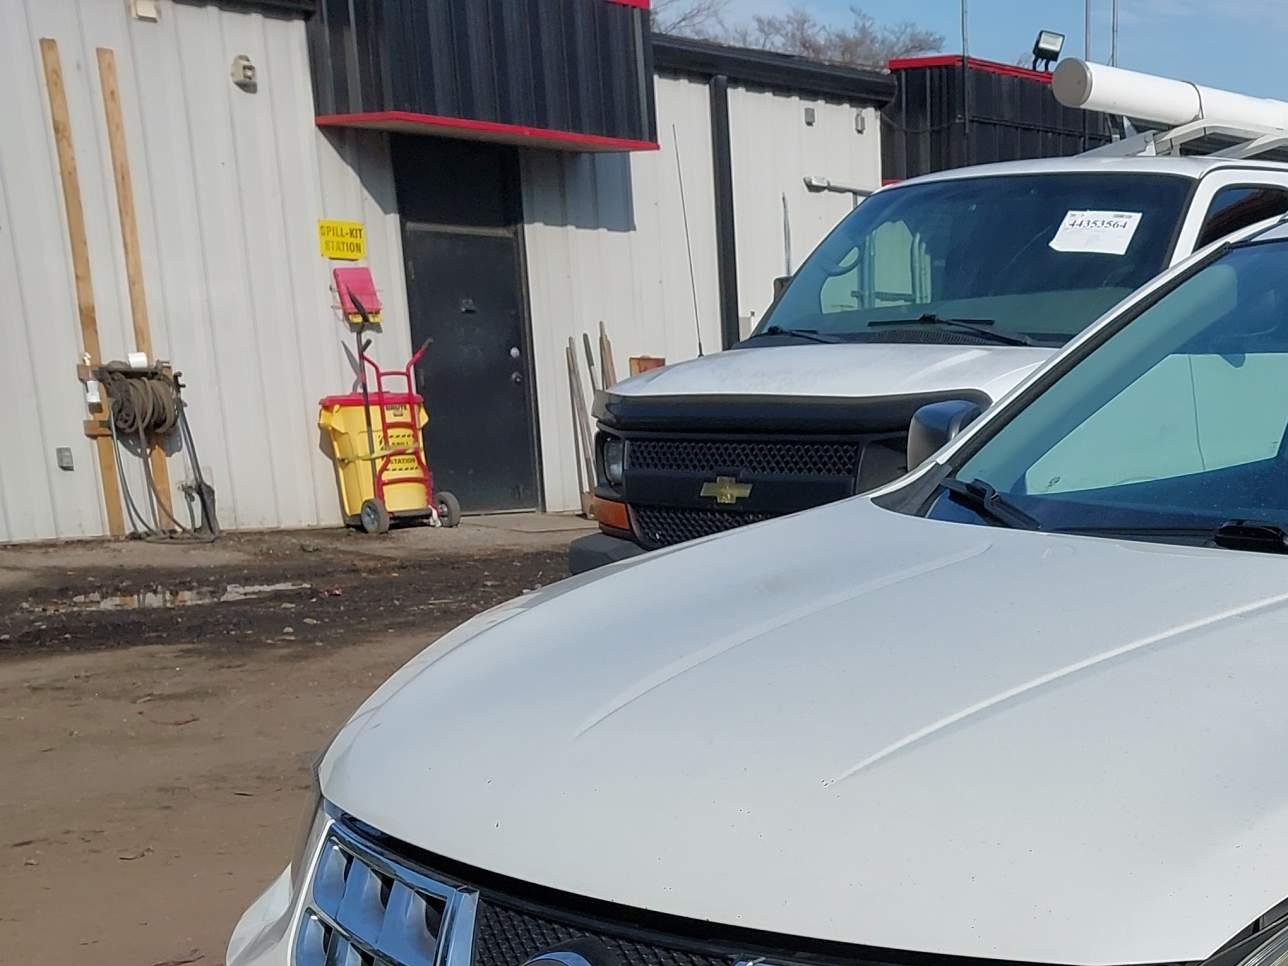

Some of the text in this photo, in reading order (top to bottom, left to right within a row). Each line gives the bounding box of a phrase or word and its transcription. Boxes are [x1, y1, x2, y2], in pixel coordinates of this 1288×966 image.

[1069, 219, 1128, 229] 44353564
[319, 225, 363, 239] SPILL-KIT
[324, 240, 362, 253] STATION
